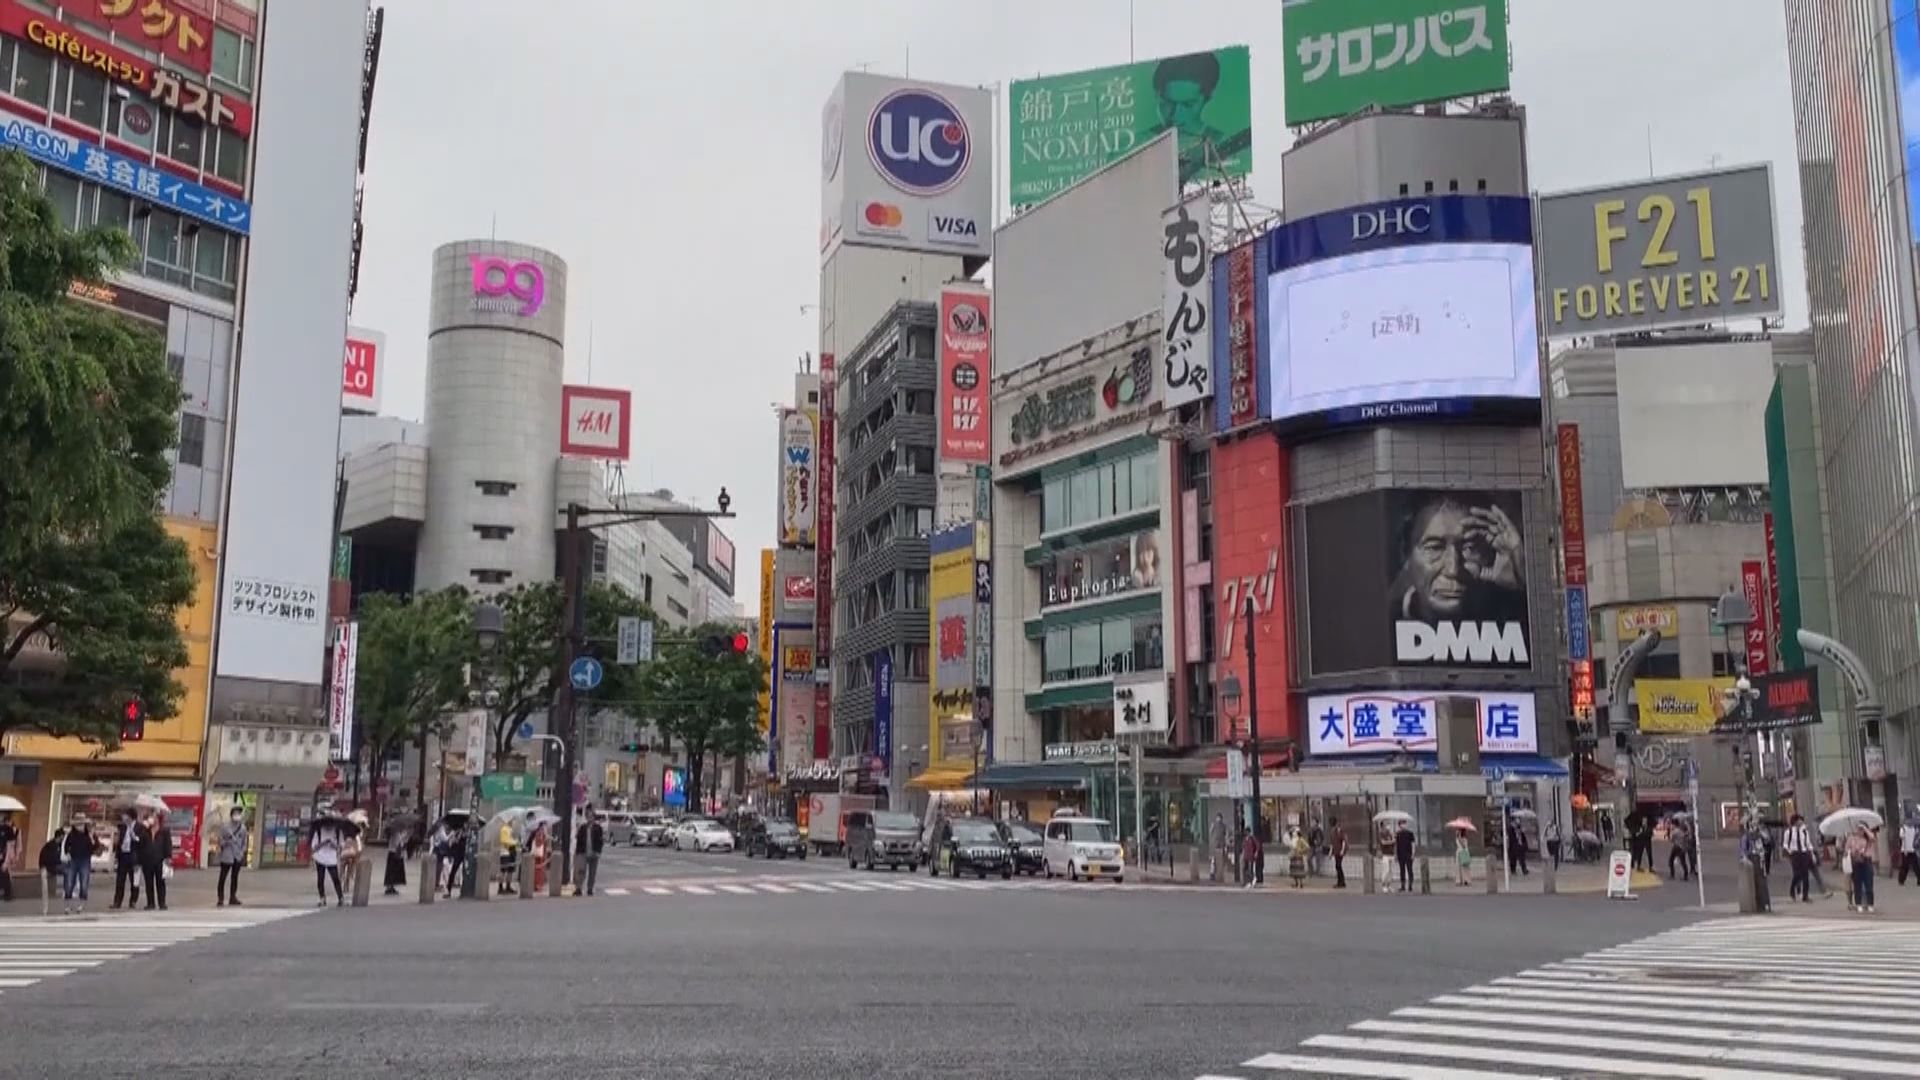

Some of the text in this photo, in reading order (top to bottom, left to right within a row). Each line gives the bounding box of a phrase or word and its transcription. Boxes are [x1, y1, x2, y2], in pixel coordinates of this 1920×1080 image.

[1297, 5, 1493, 83] サロンパス
[150, 68, 235, 126] ガスト
[5, 120, 70, 161] AEON
[880, 112, 961, 167] UC
[1021, 128, 1136, 165] NOMAD
[935, 216, 977, 236] VISA
[1351, 205, 1431, 241] DHC
[1594, 187, 1716, 274] F21
[469, 254, 545, 318] 109
[1165, 207, 1209, 394] もんじゃ
[1553, 263, 1769, 323] FOREVER 21
[577, 411, 613, 435] H&M
[1361, 400, 1438, 418] DHC Channel
[1048, 573, 1128, 603] Euphoria
[1395, 620, 1529, 662] DMM
[1320, 701, 1519, 739] 大盛堂店
